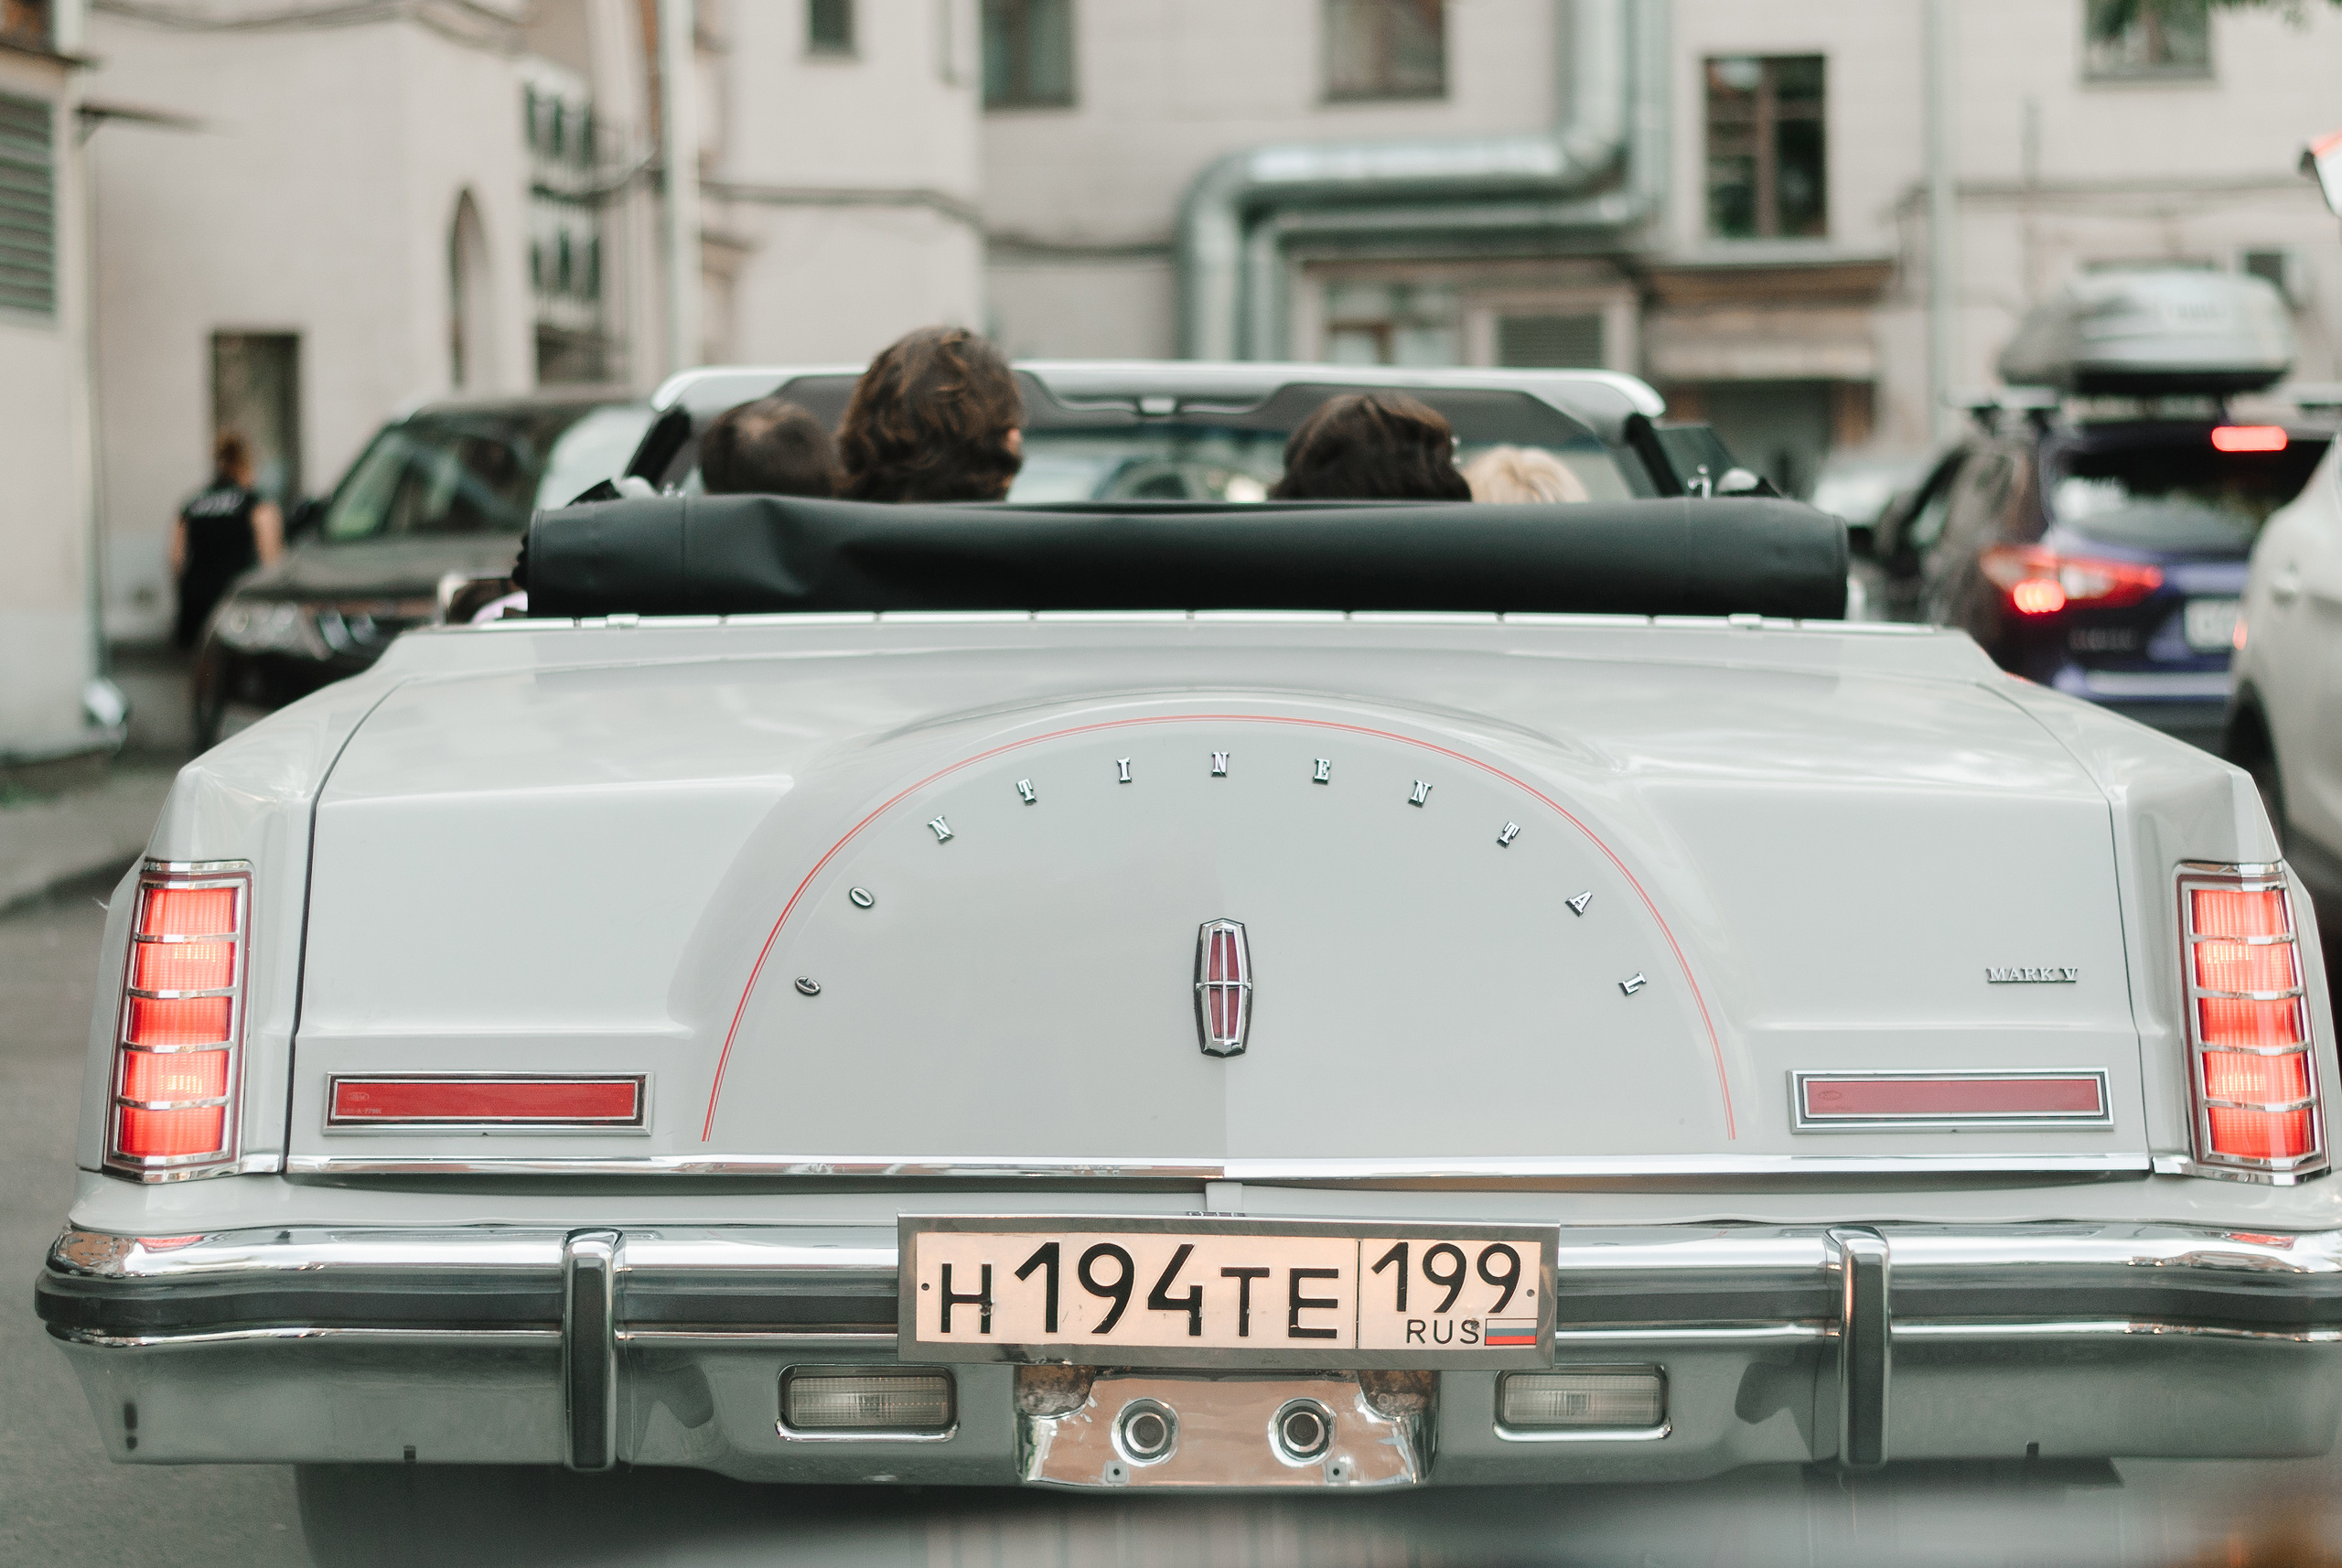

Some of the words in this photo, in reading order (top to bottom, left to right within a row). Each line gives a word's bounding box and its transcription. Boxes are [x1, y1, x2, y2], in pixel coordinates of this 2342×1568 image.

[794, 750, 1647, 997] CONTINENTAL
[1985, 967, 2055, 983] MARK
[2058, 967, 2078, 983] V
[1370, 1240, 1521, 1314] 199
[1405, 1318, 1479, 1345] RUS
